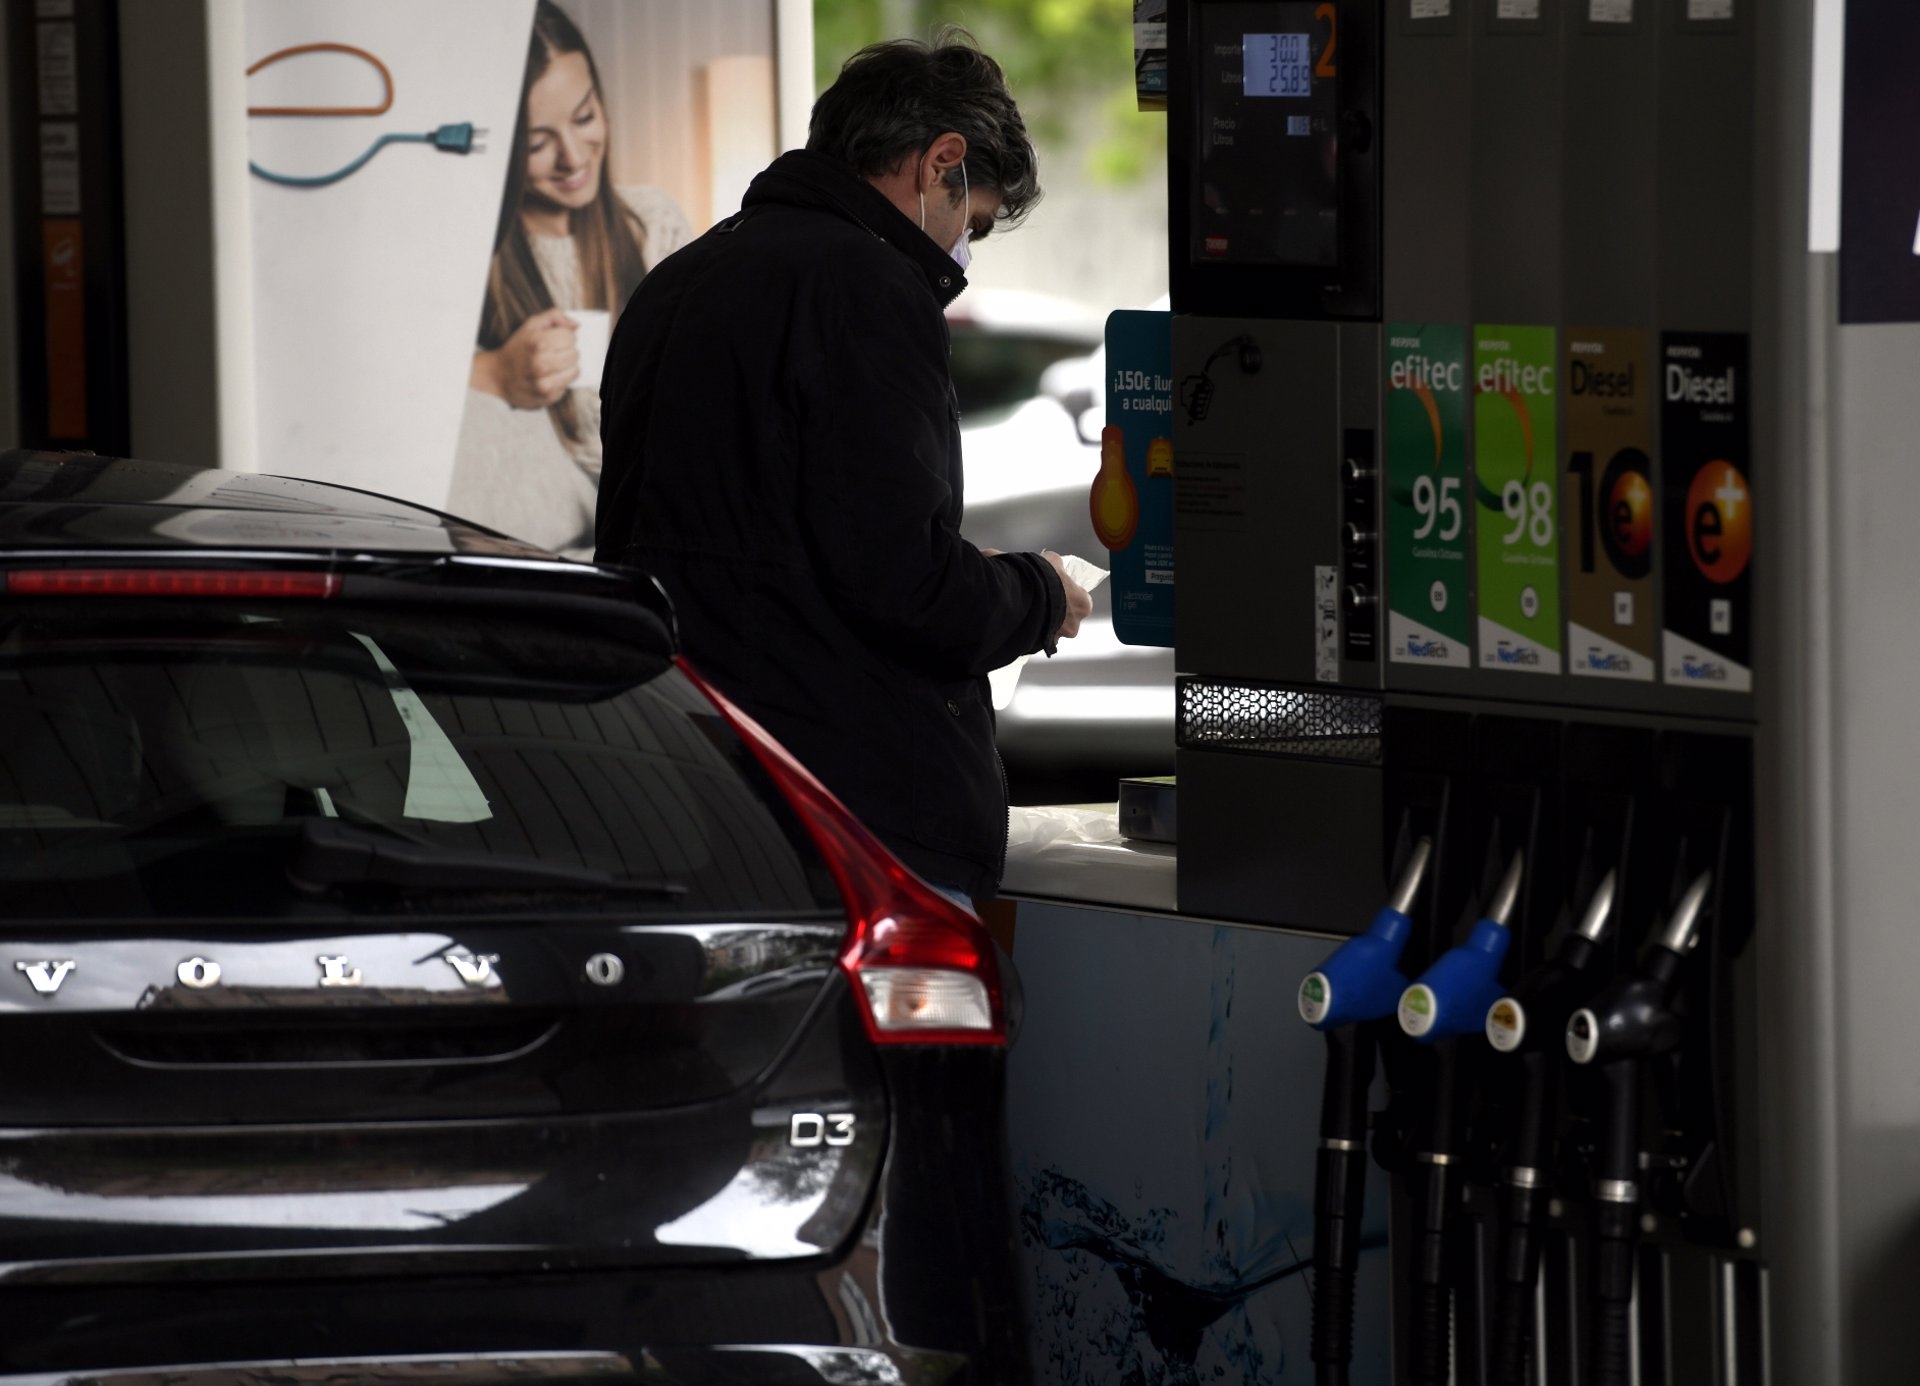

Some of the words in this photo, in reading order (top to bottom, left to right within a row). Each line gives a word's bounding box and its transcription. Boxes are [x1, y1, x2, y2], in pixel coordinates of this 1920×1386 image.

[1315, 3, 1338, 77] 2
[1390, 355, 1461, 391] efitec
[1478, 357, 1553, 395] efitec
[1571, 360, 1635, 398] Diesel
[1665, 363, 1736, 404] Diesel
[1122, 398, 1130, 410] a
[1412, 475, 1462, 541] 95
[1502, 480, 1553, 546] 98
[790, 1113, 856, 1147] D3
